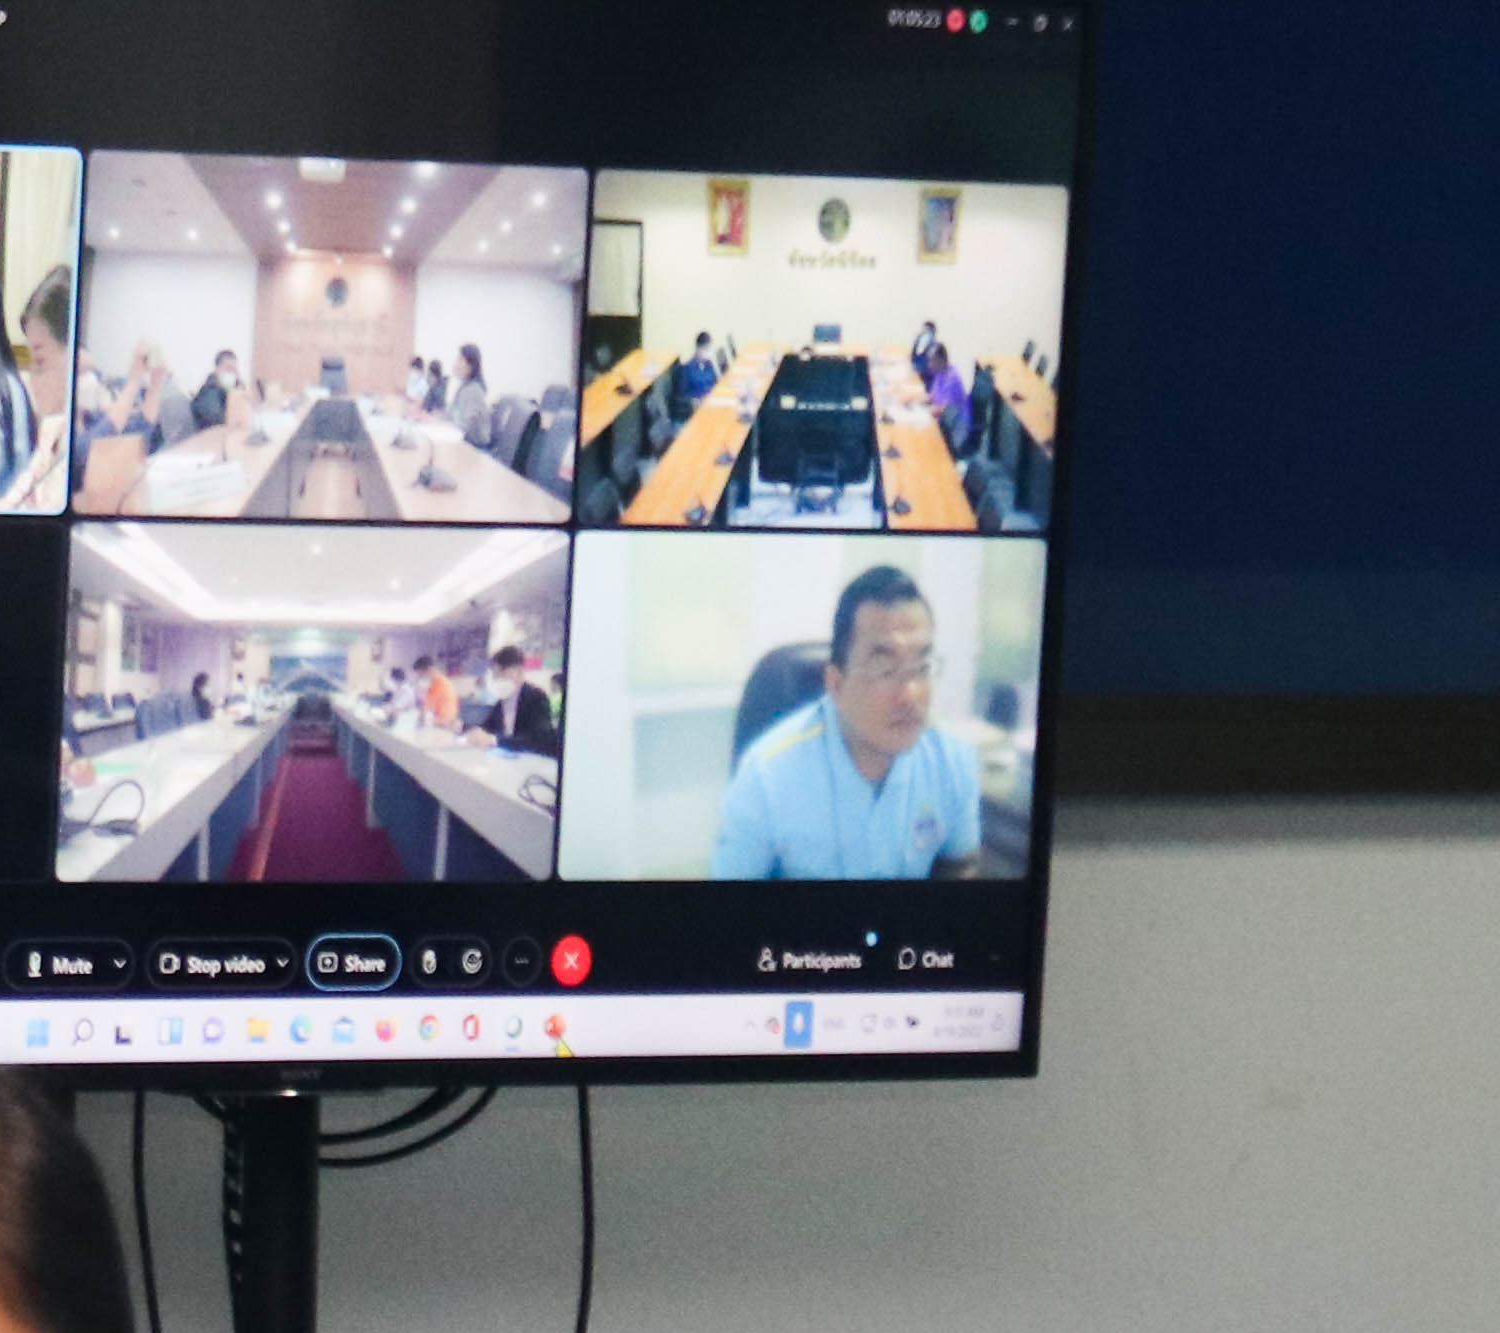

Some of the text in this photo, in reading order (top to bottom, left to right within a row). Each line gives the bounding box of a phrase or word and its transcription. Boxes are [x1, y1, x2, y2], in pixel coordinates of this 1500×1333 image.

[52, 954, 93, 974] Mute
[187, 954, 265, 978] Stop video
[345, 954, 386, 973] Share
[782, 951, 863, 973] Participants
[922, 951, 955, 968] Chat
